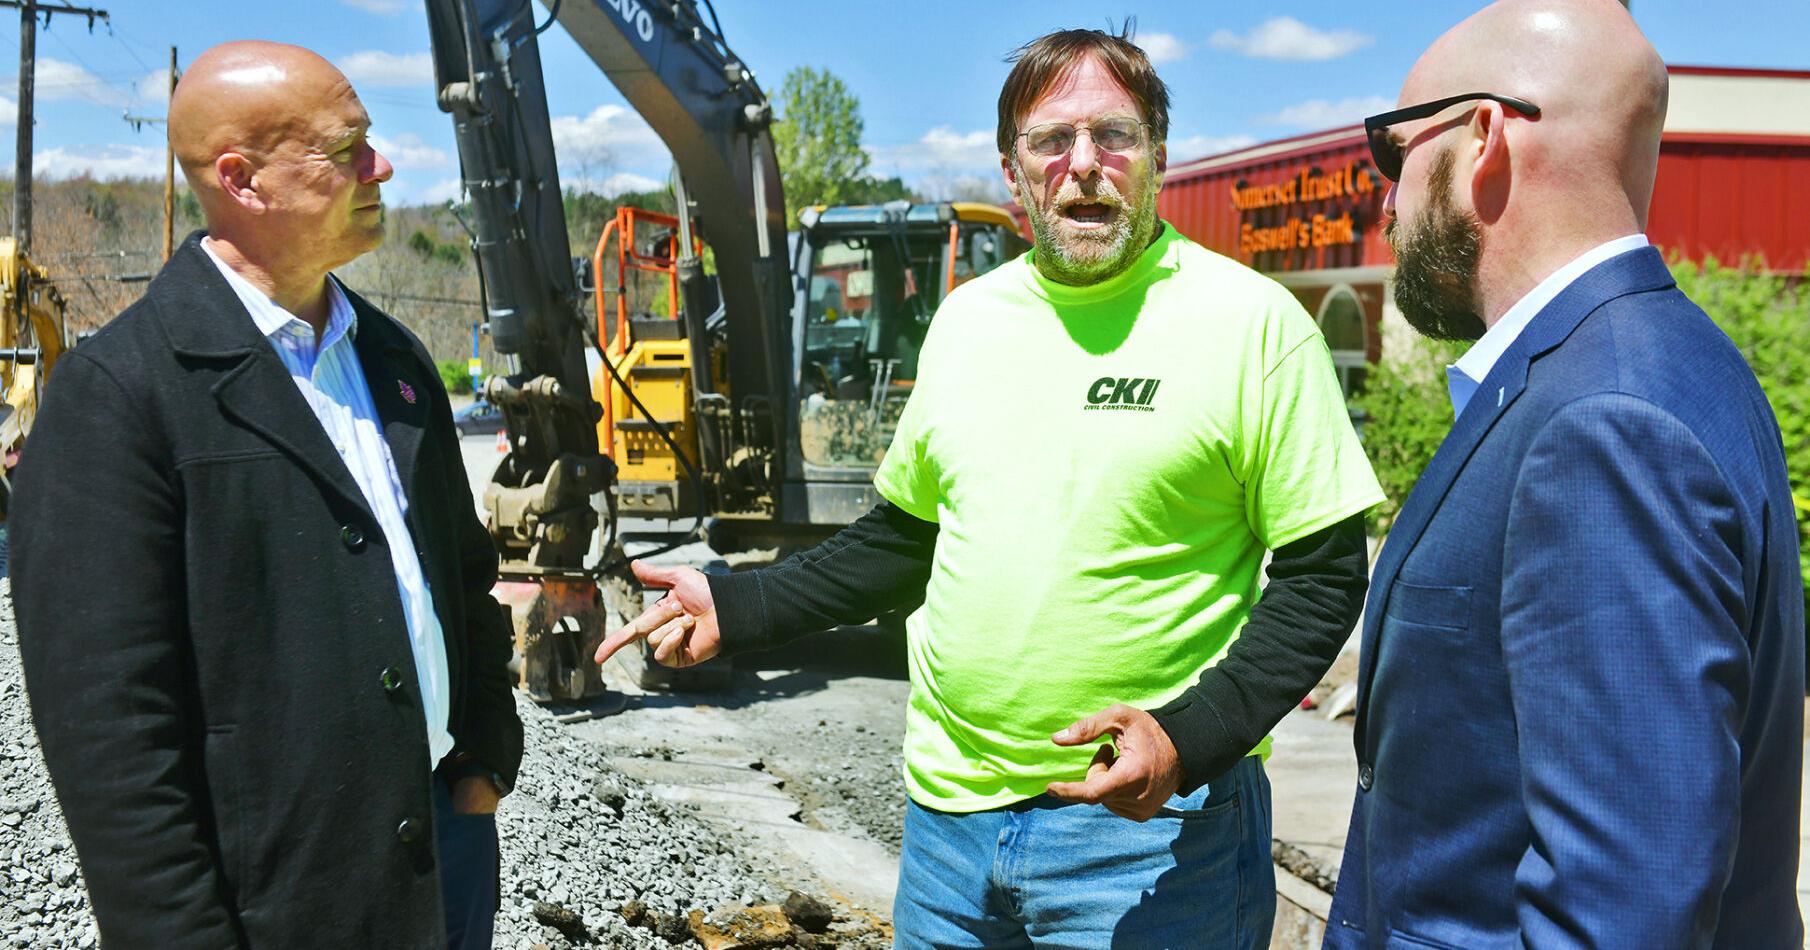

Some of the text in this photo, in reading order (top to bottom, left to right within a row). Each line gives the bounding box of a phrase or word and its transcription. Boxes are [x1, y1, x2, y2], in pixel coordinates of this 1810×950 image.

[1231, 178, 1296, 211] Somerset
[1299, 166, 1344, 202] Trust
[1311, 211, 1354, 248] Bank
[1101, 404, 1155, 412] CONSTRUCTION
